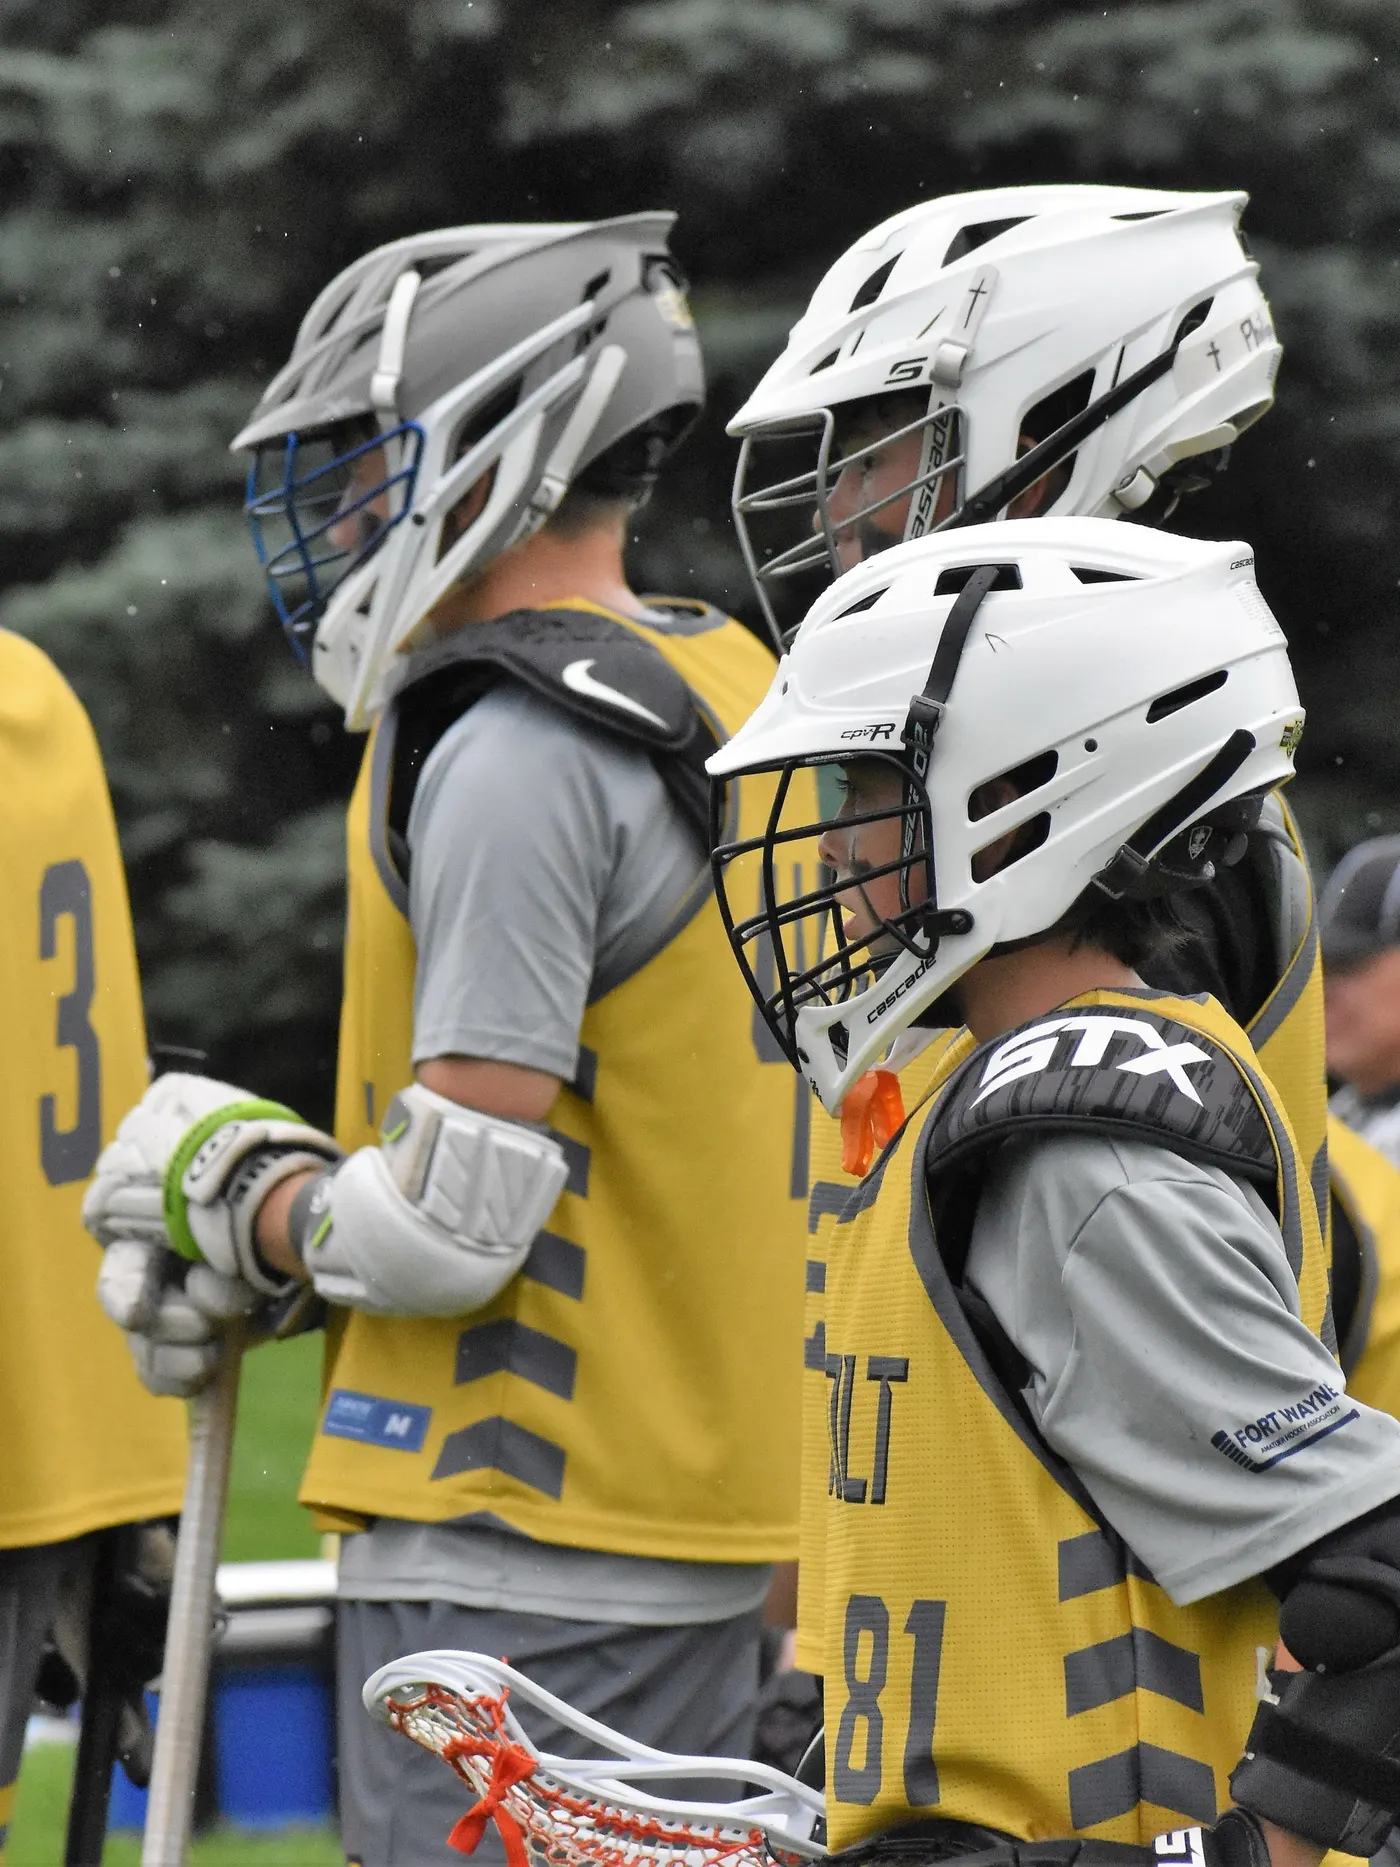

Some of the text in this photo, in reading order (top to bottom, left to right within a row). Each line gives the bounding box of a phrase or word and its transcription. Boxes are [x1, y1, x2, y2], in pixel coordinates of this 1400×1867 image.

[39, 858, 103, 1188] 3
[866, 954, 937, 1024] cascade
[969, 1015, 1212, 1110] STX
[1233, 1383, 1339, 1449] FORT WAYNE
[1284, 1424, 1308, 1441] HOCKEY
[1307, 1405, 1341, 1429] ASSOCIATION
[833, 1593, 947, 1807] 81
